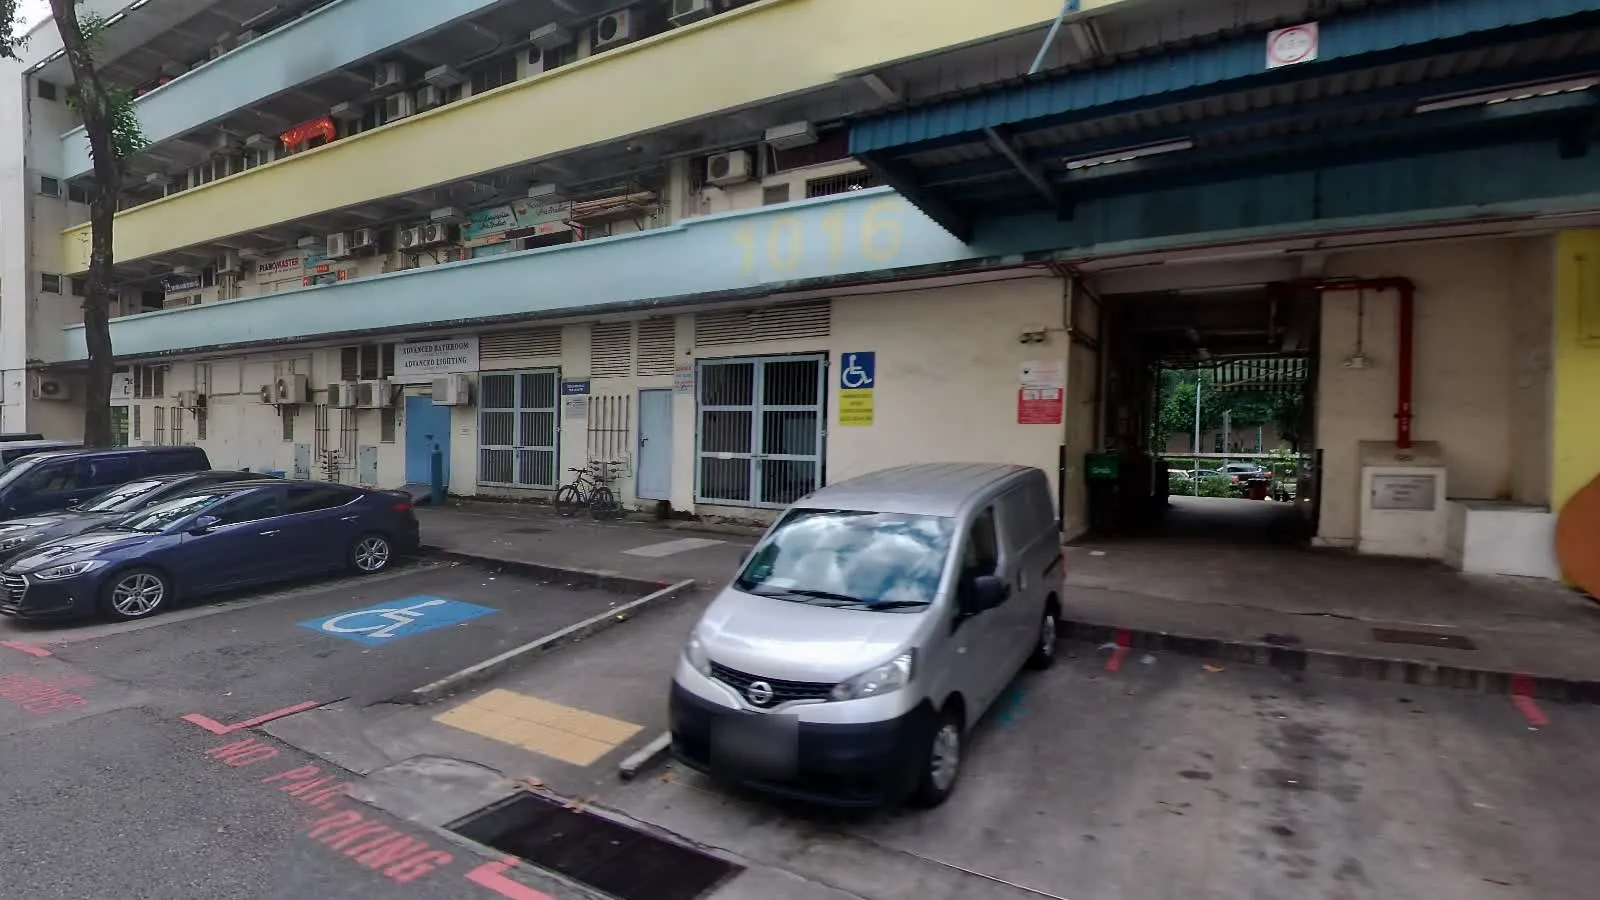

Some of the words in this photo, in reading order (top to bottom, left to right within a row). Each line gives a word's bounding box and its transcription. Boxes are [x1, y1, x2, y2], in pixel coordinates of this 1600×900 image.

[732, 199, 902, 280] 1016
[403, 345, 433, 355] ADVANCED
[434, 341, 469, 352] BATHROOM
[404, 359, 435, 368] ADVANCED
[436, 356, 467, 366] LIGHTING
[204, 738, 279, 767] NO
